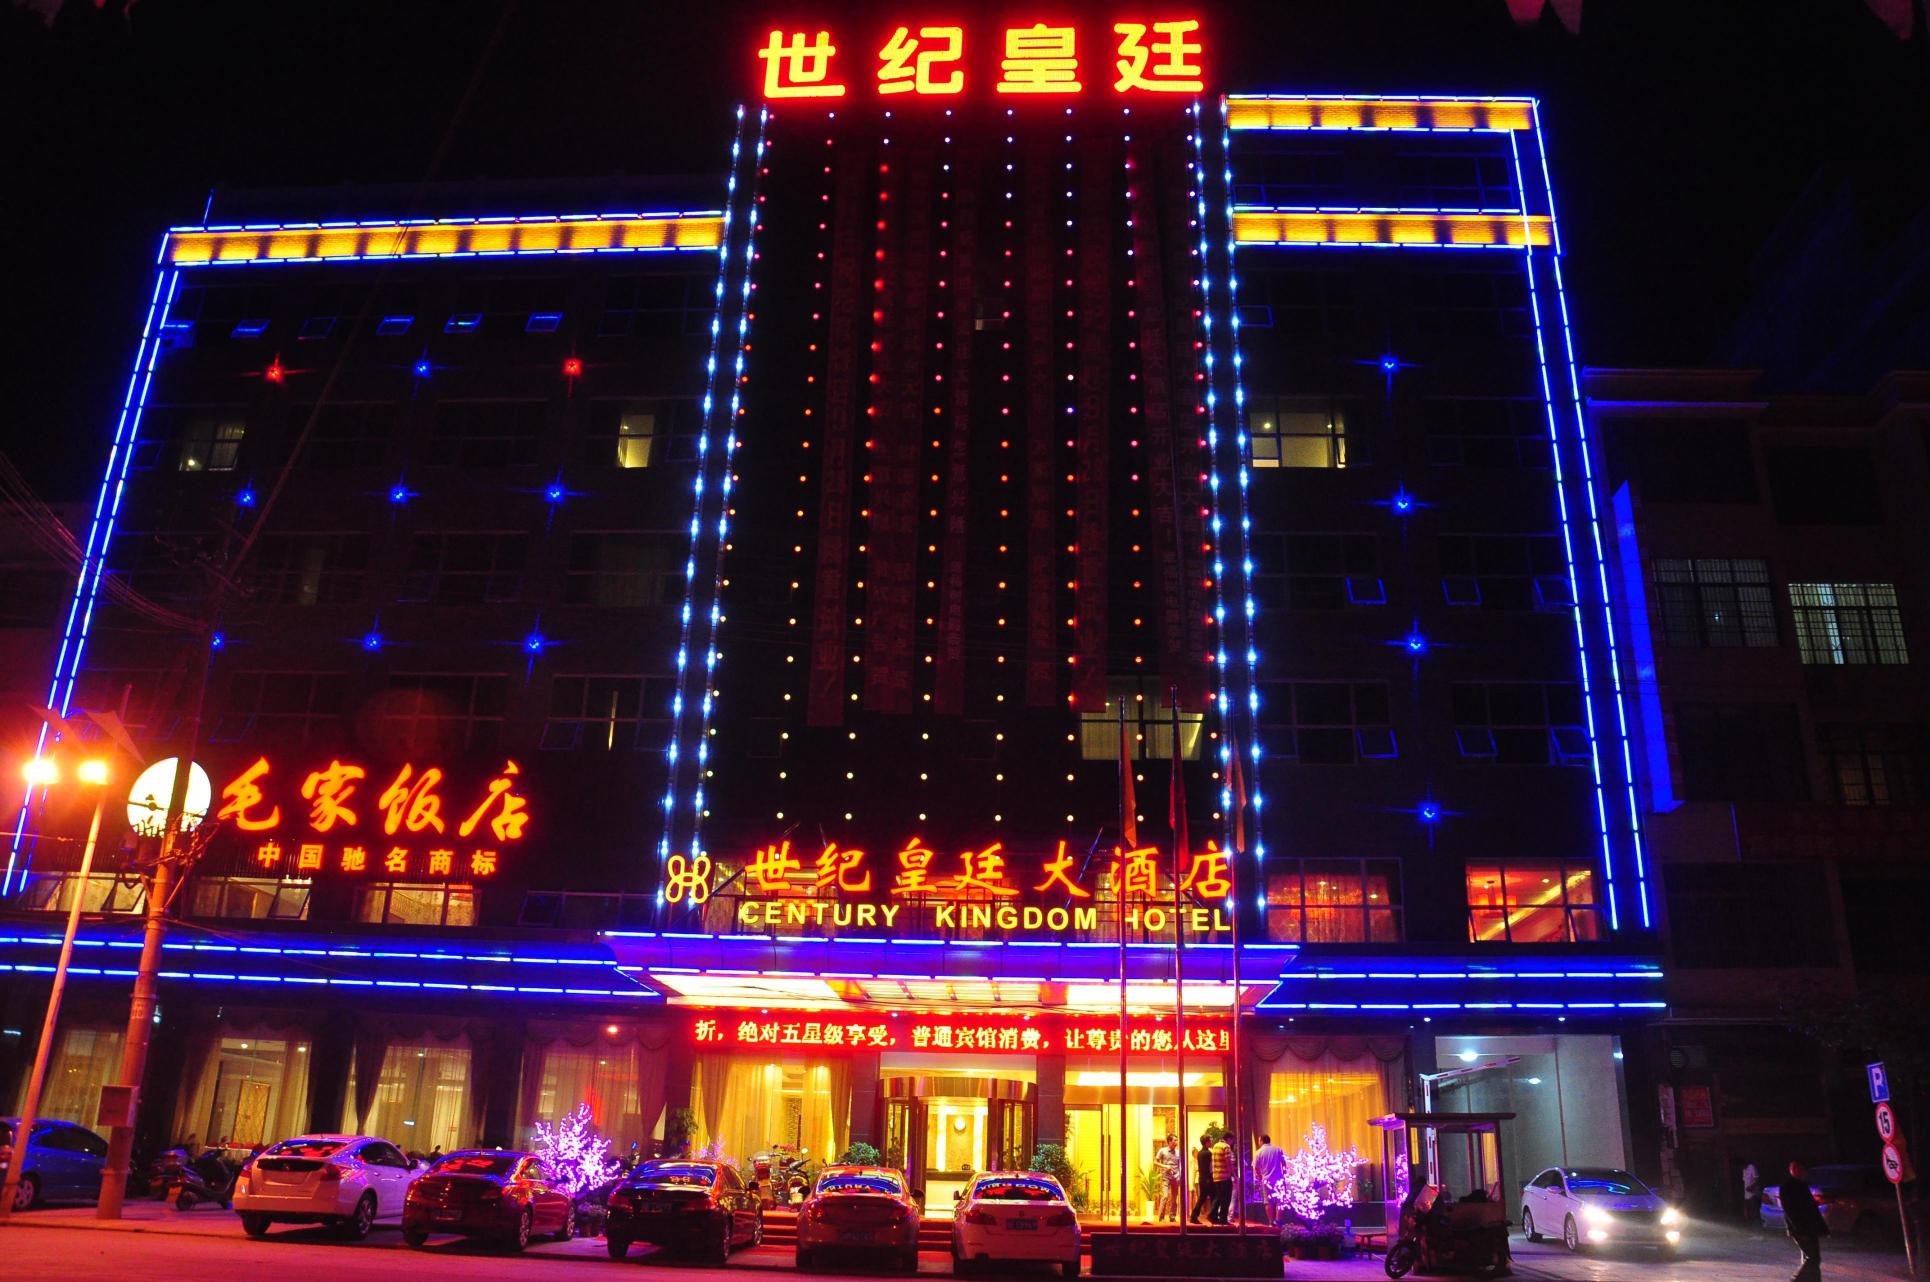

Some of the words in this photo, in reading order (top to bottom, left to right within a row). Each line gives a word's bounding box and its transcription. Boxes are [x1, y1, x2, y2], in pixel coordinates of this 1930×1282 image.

[758, 20, 1204, 98] 世纪皇廷
[217, 756, 529, 841] 毛家饭店
[257, 842, 497, 875] 中国驰名商标
[745, 837, 1231, 898] 世纪皇廷大酒店
[740, 901, 900, 927] CENTURY
[935, 905, 1097, 931] KINGDOM
[1872, 1067, 1883, 1098] P
[1878, 1111, 1891, 1134] 15
